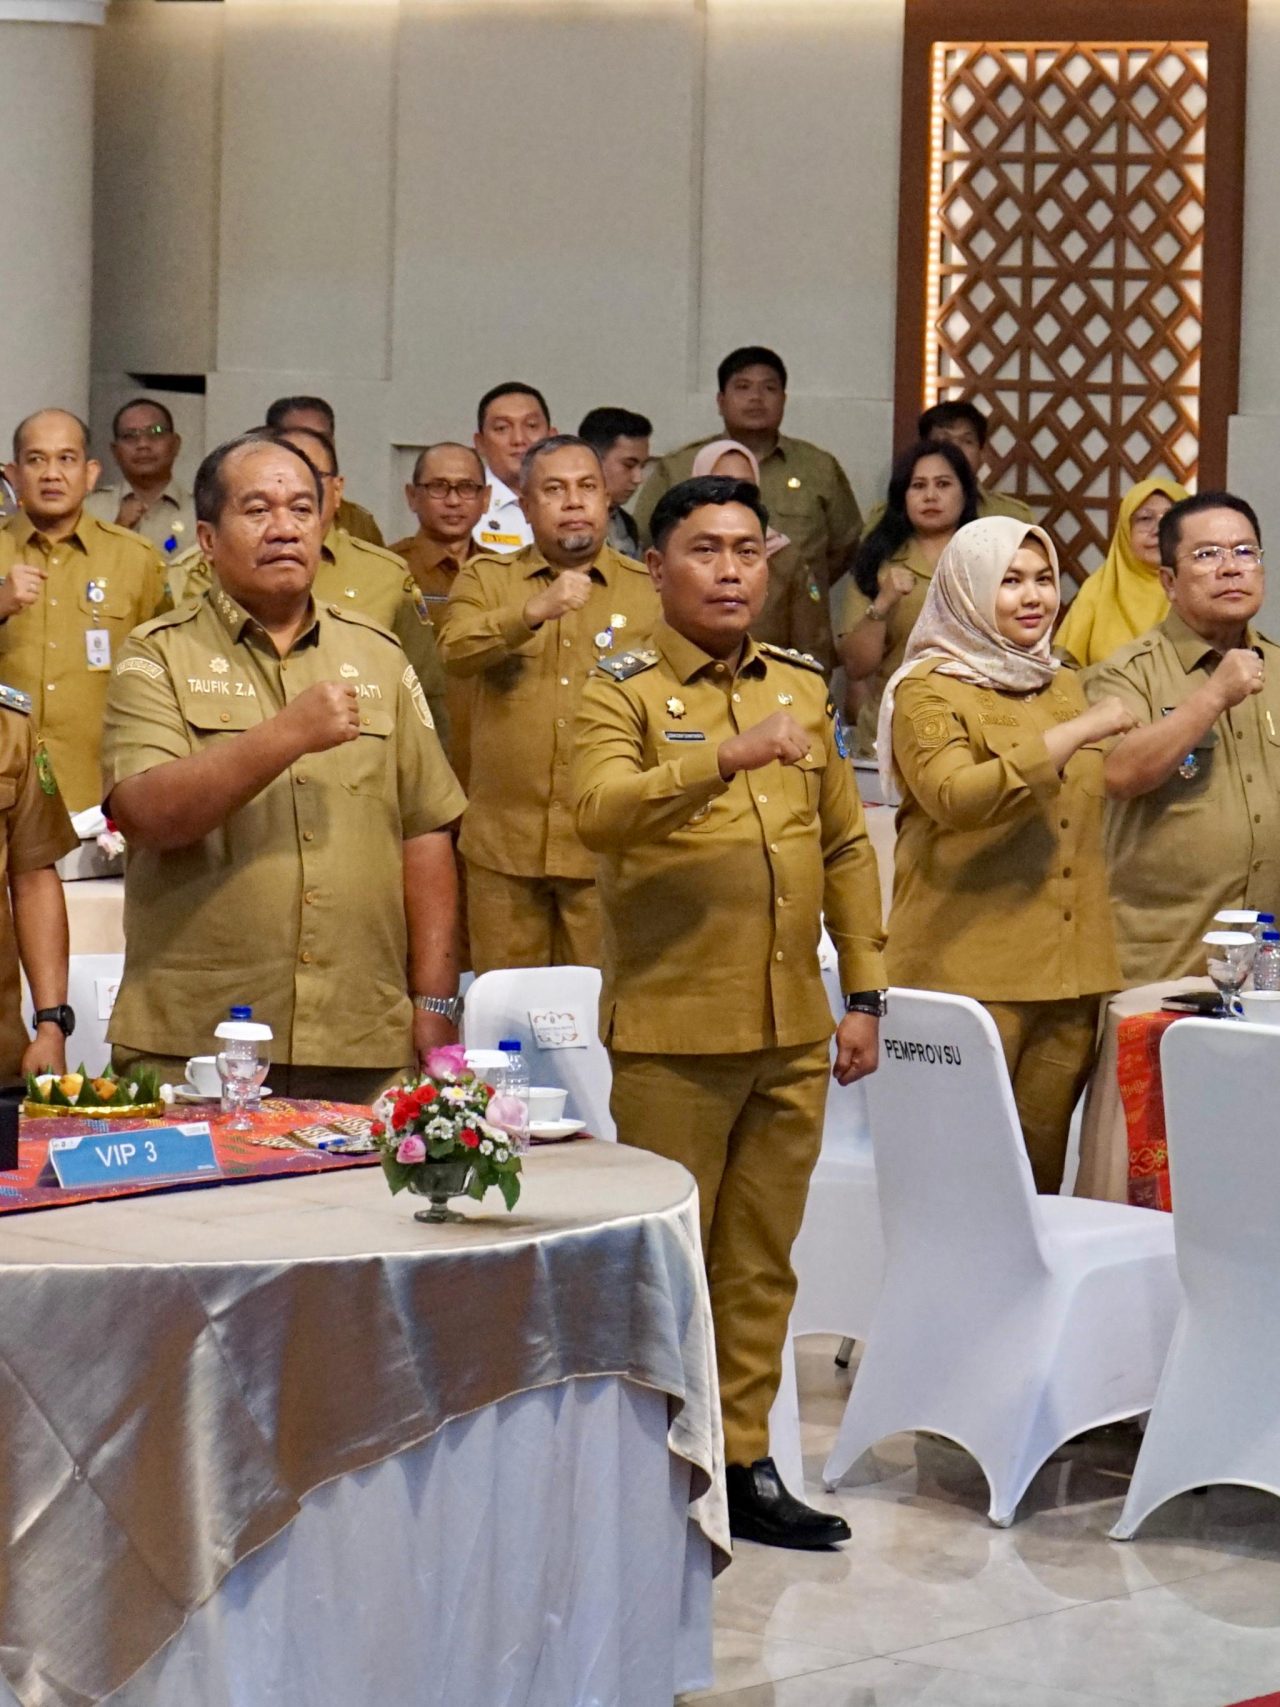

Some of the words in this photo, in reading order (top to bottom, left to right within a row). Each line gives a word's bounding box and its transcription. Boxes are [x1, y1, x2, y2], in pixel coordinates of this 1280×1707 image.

[188, 679, 230, 695] TAUFIK
[235, 683, 256, 697] Z.A
[884, 1039, 962, 1066] PEMPROVSU
[95, 1143, 136, 1167] VIP
[145, 1140, 157, 1163] 3
